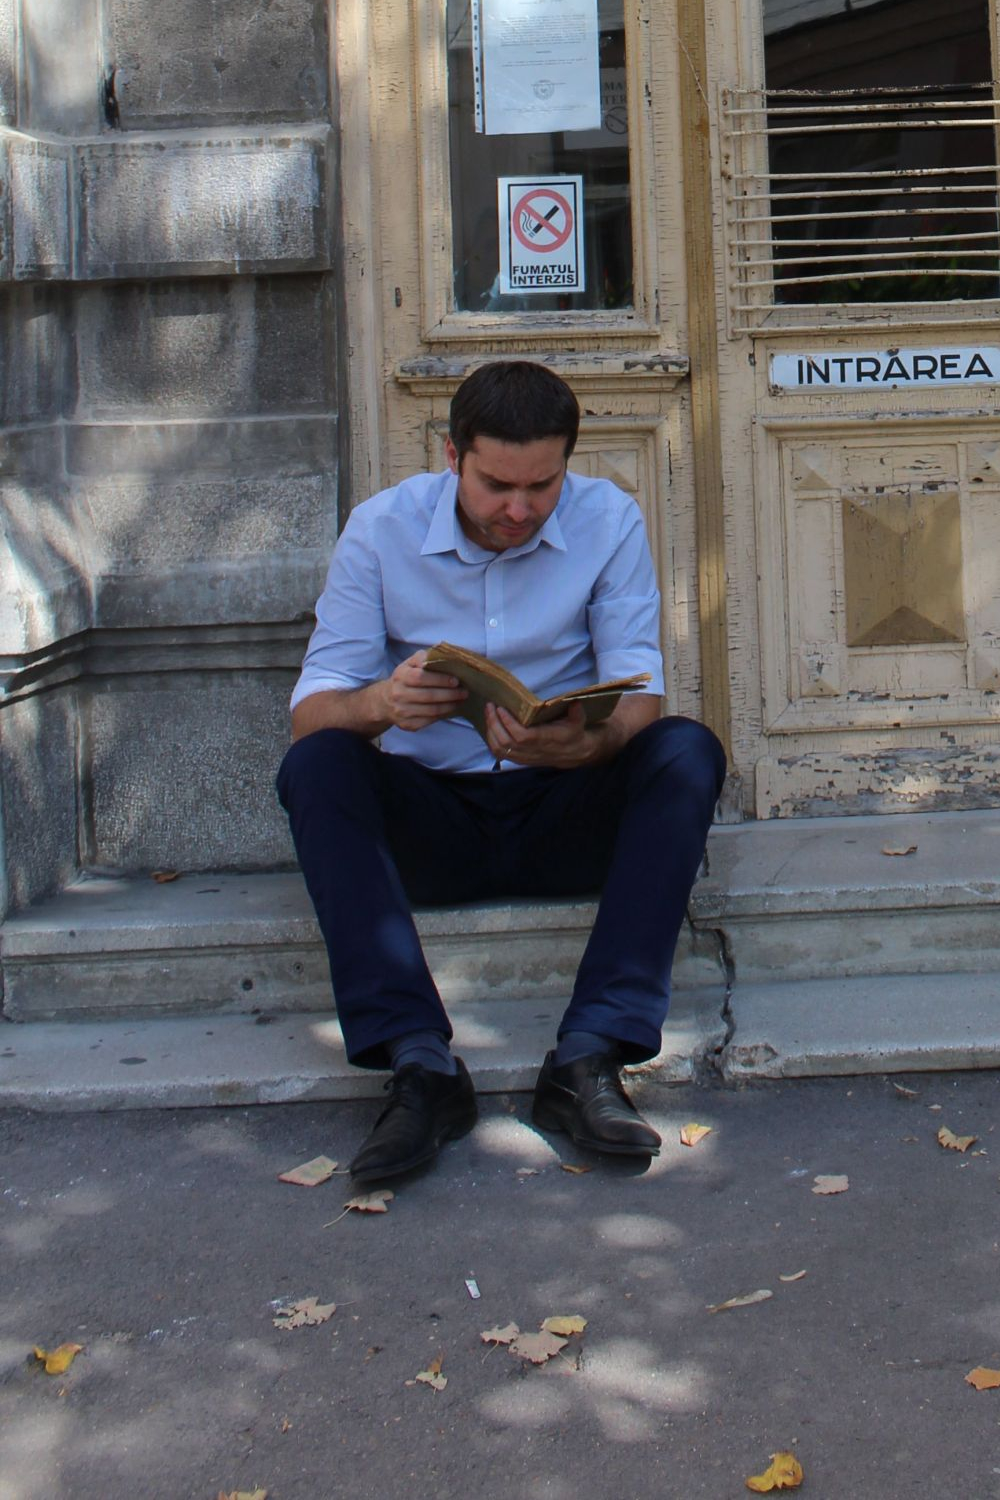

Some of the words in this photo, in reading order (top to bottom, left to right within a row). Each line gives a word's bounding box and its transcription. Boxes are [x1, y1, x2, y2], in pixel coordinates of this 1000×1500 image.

[512, 264, 575, 275] FUMATUL
[513, 274, 575, 285] INTERZIS
[797, 353, 994, 385] INTRAREA
